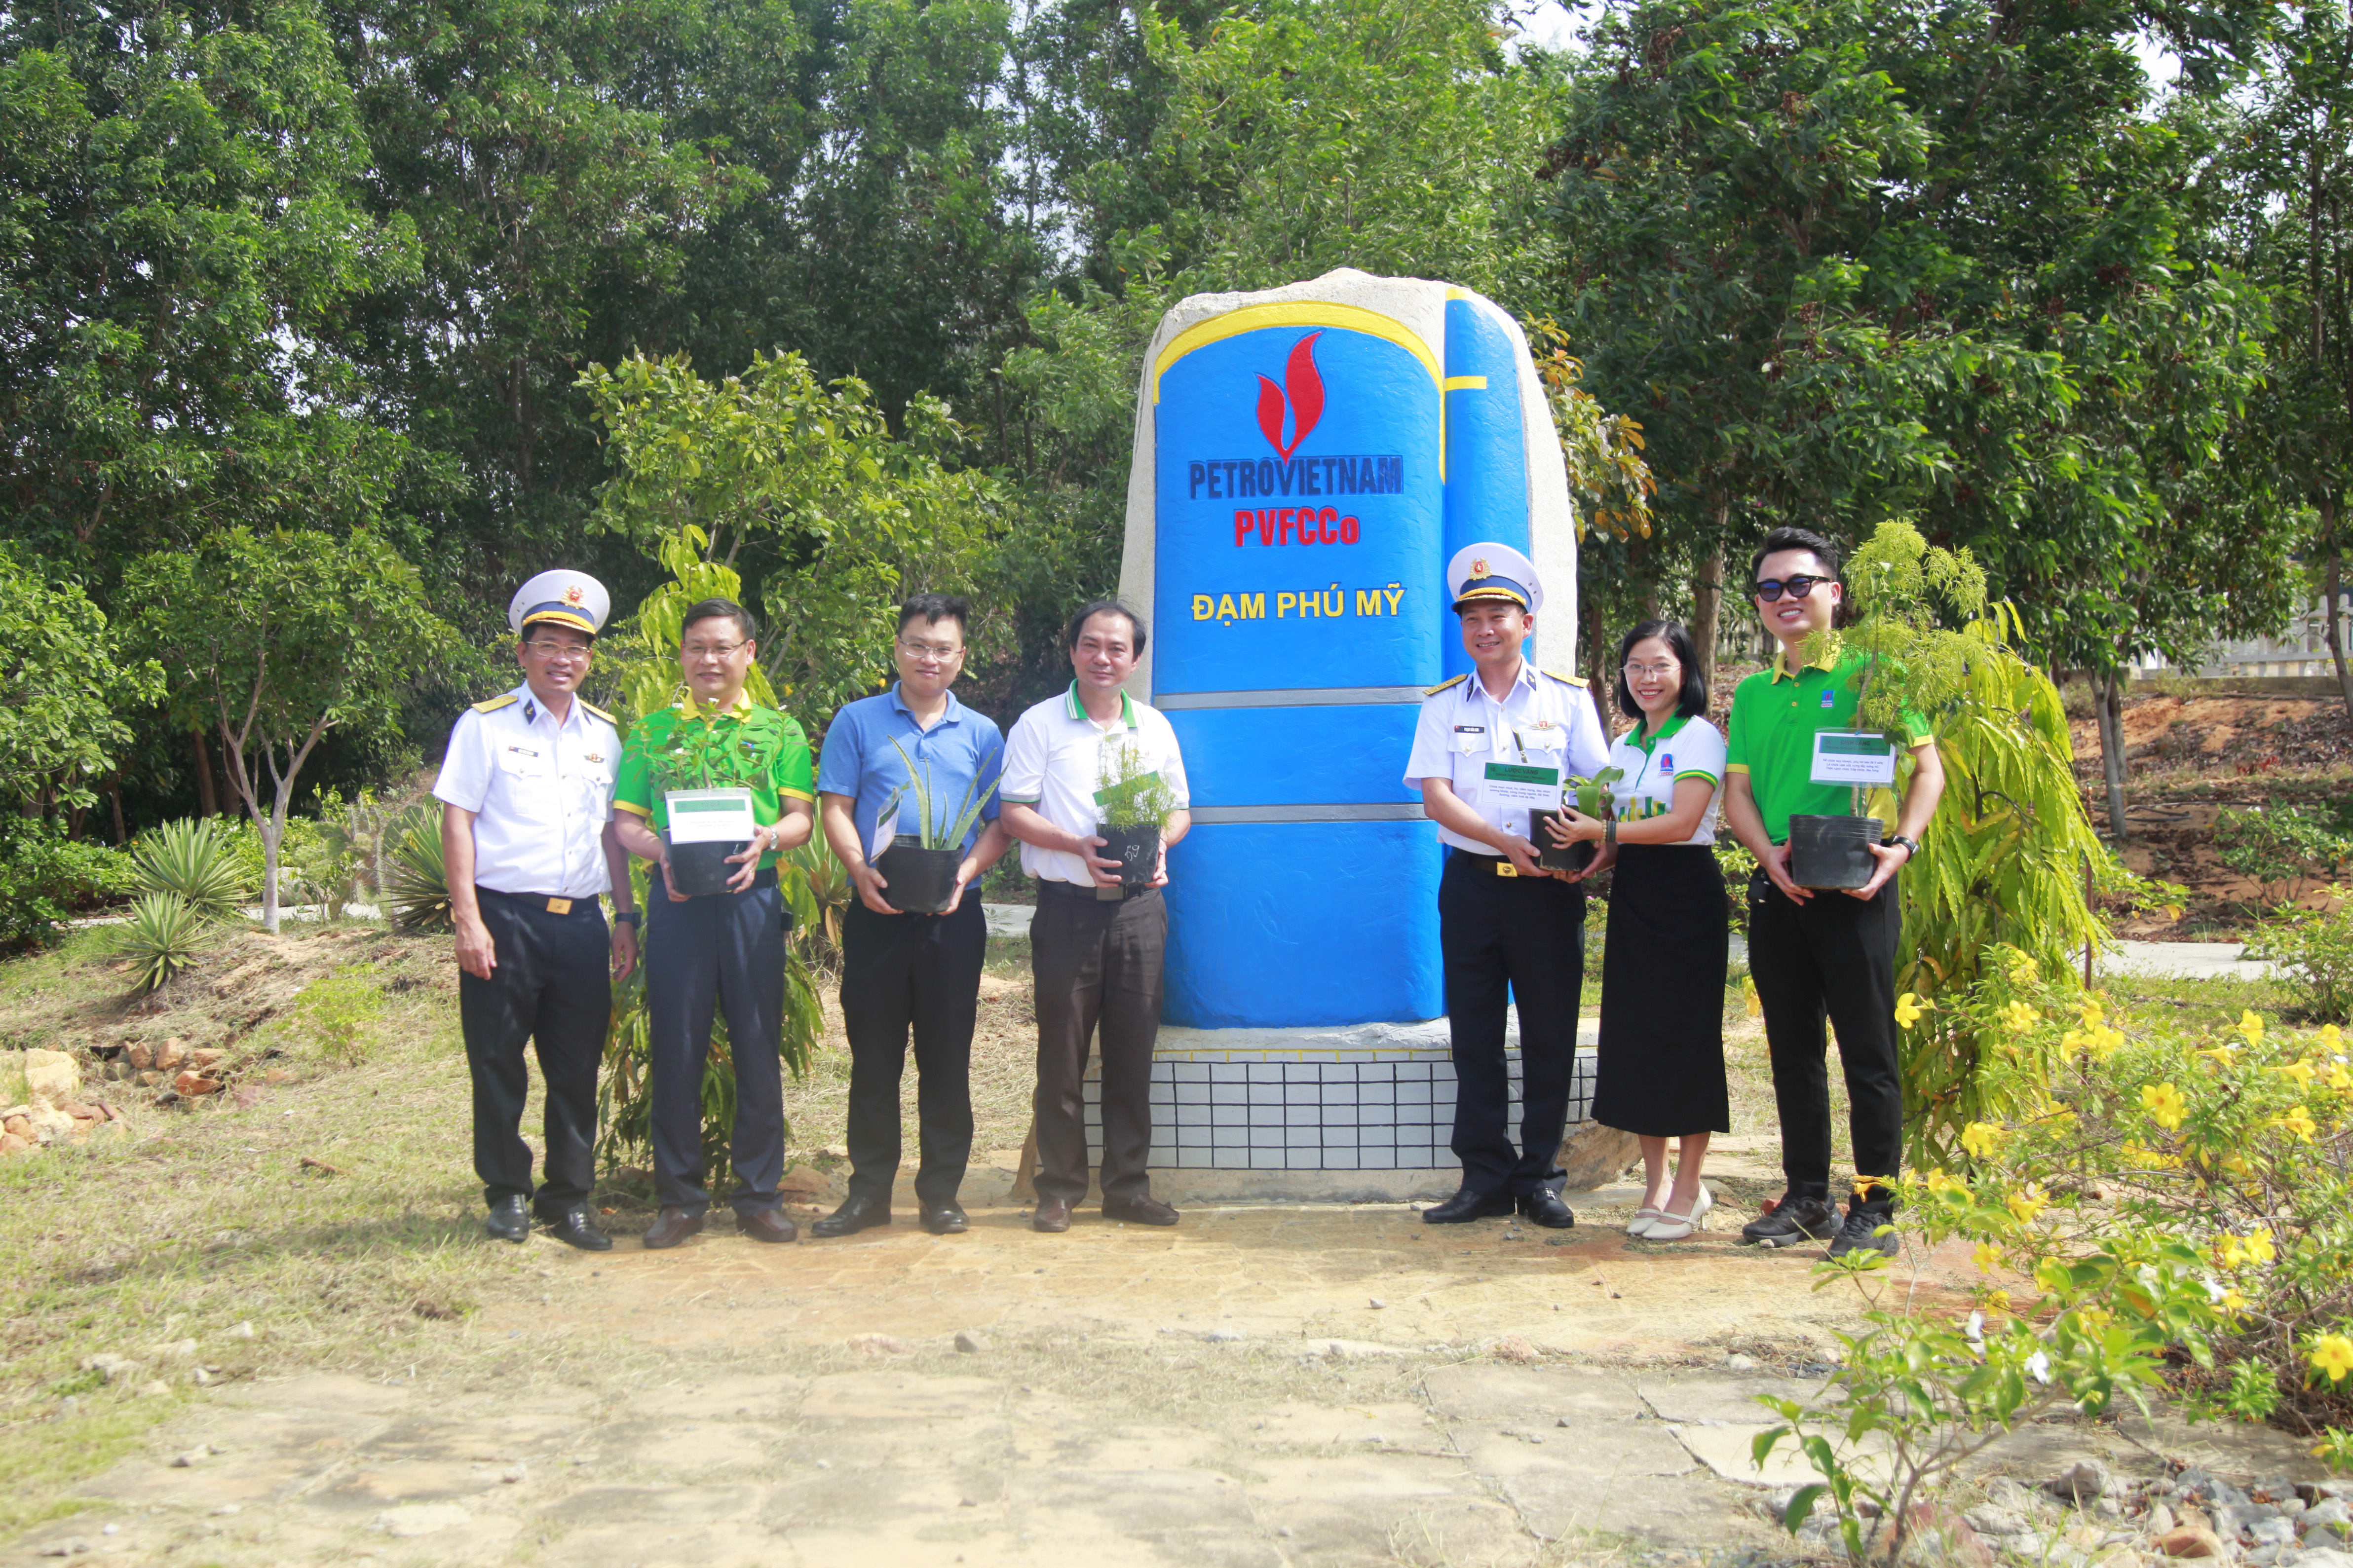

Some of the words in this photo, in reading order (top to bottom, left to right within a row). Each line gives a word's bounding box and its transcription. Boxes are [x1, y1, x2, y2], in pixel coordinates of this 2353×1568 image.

[1189, 457, 1402, 499] PETROVIETNAM
[1235, 507, 1359, 547] PVFCCo
[1191, 593, 1266, 627] ĐẠM
[1277, 584, 1344, 618] PHÚ
[1356, 583, 1405, 616] MỸ
